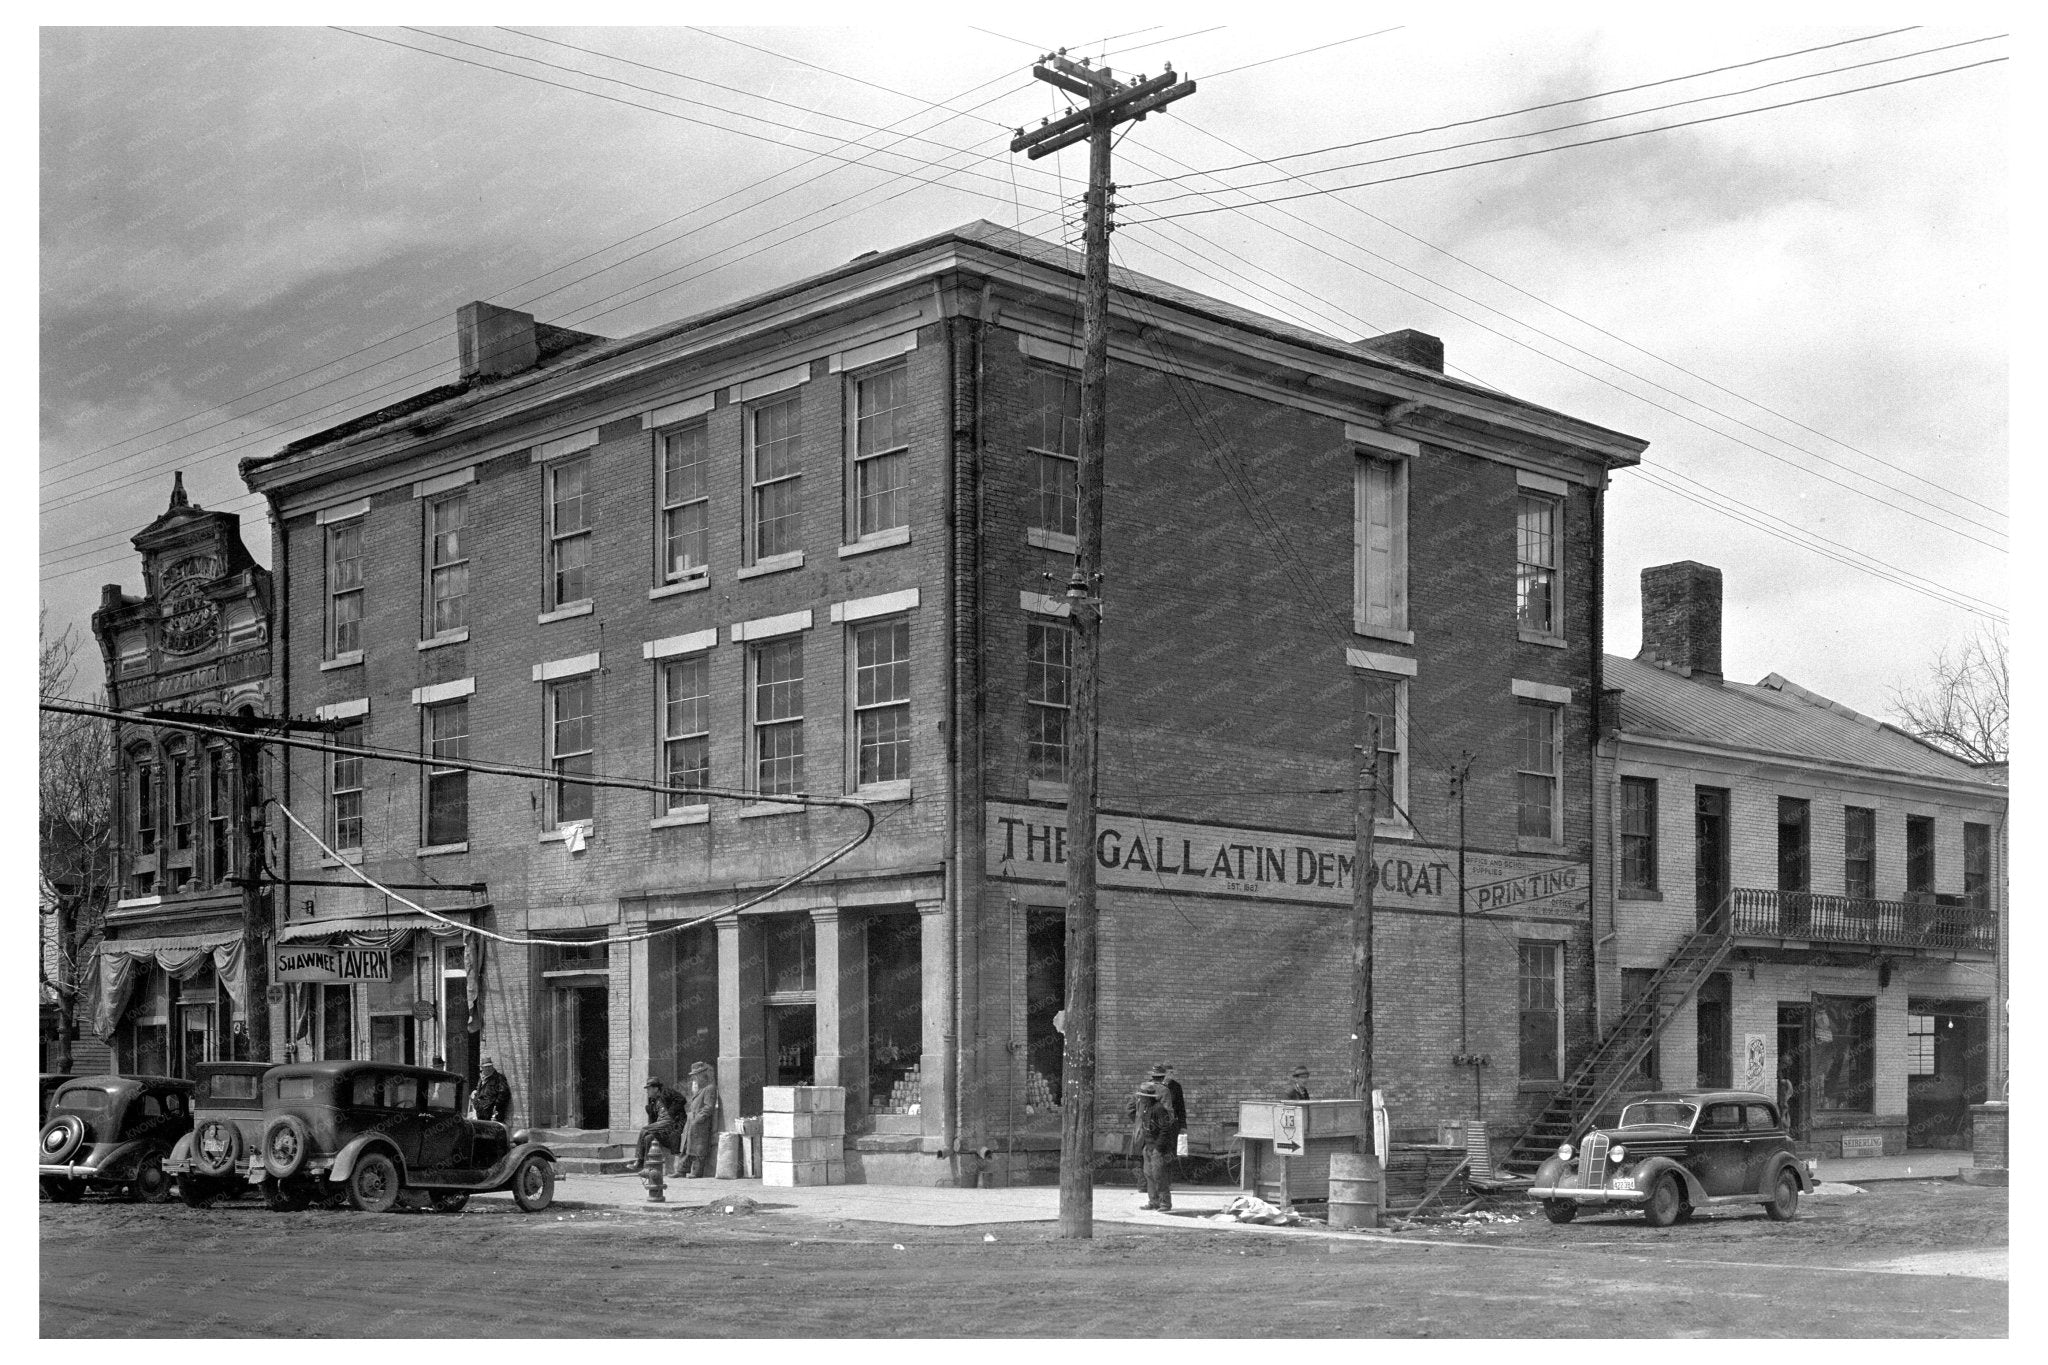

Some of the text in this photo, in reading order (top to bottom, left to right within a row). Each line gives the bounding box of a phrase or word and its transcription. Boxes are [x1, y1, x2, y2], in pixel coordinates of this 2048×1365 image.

[998, 816, 1067, 863] THE
[1097, 828, 1286, 883] GALLATIN
[1478, 868, 1577, 910] PRINTING
[278, 950, 389, 979] SHAWNEE TAVERN
[1285, 1115, 1295, 1127] 13
[1843, 1138, 1882, 1148] SEIBERLING
